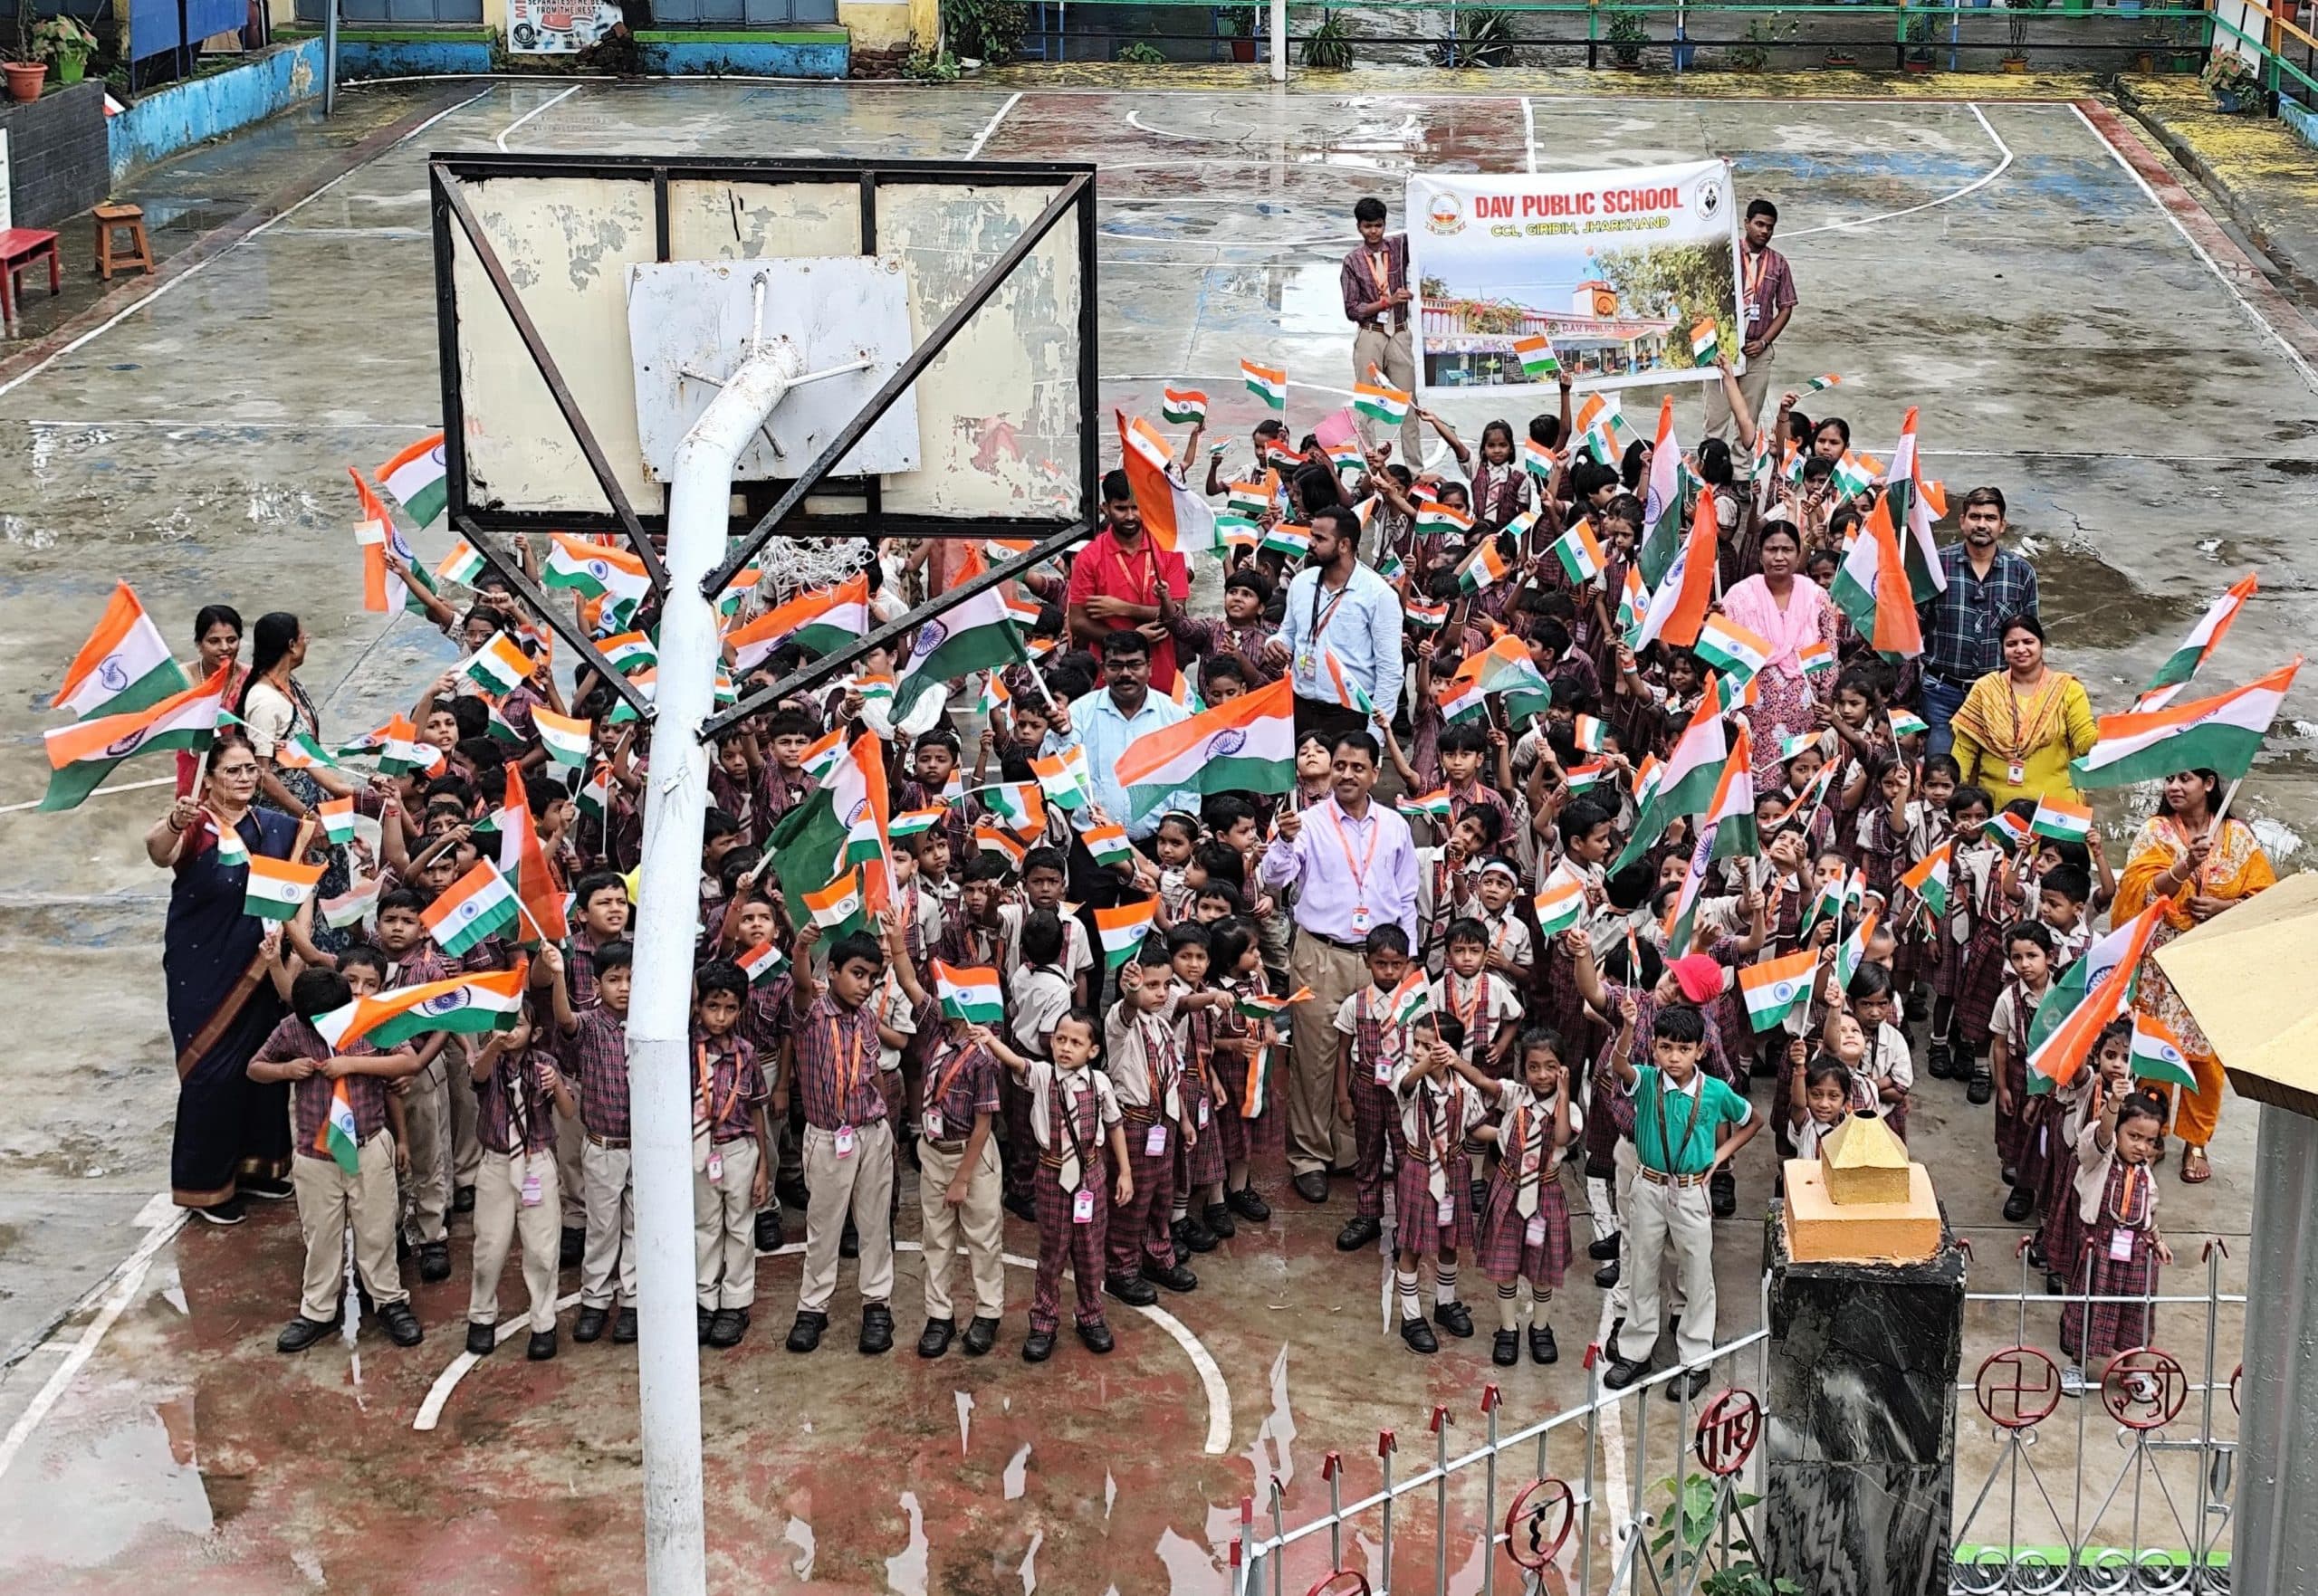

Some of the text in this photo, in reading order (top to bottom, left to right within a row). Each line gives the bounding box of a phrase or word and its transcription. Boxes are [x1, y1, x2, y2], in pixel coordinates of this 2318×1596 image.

[536, 6, 556, 14] FROM
[560, 6, 574, 14] THE
[1475, 196, 1515, 218] DAV
[1522, 191, 1595, 217] PUBLIC
[1603, 187, 1683, 214] SCHOOL
[1491, 216, 1670, 238] CCL, GIRIDIH, JHARKHAND
